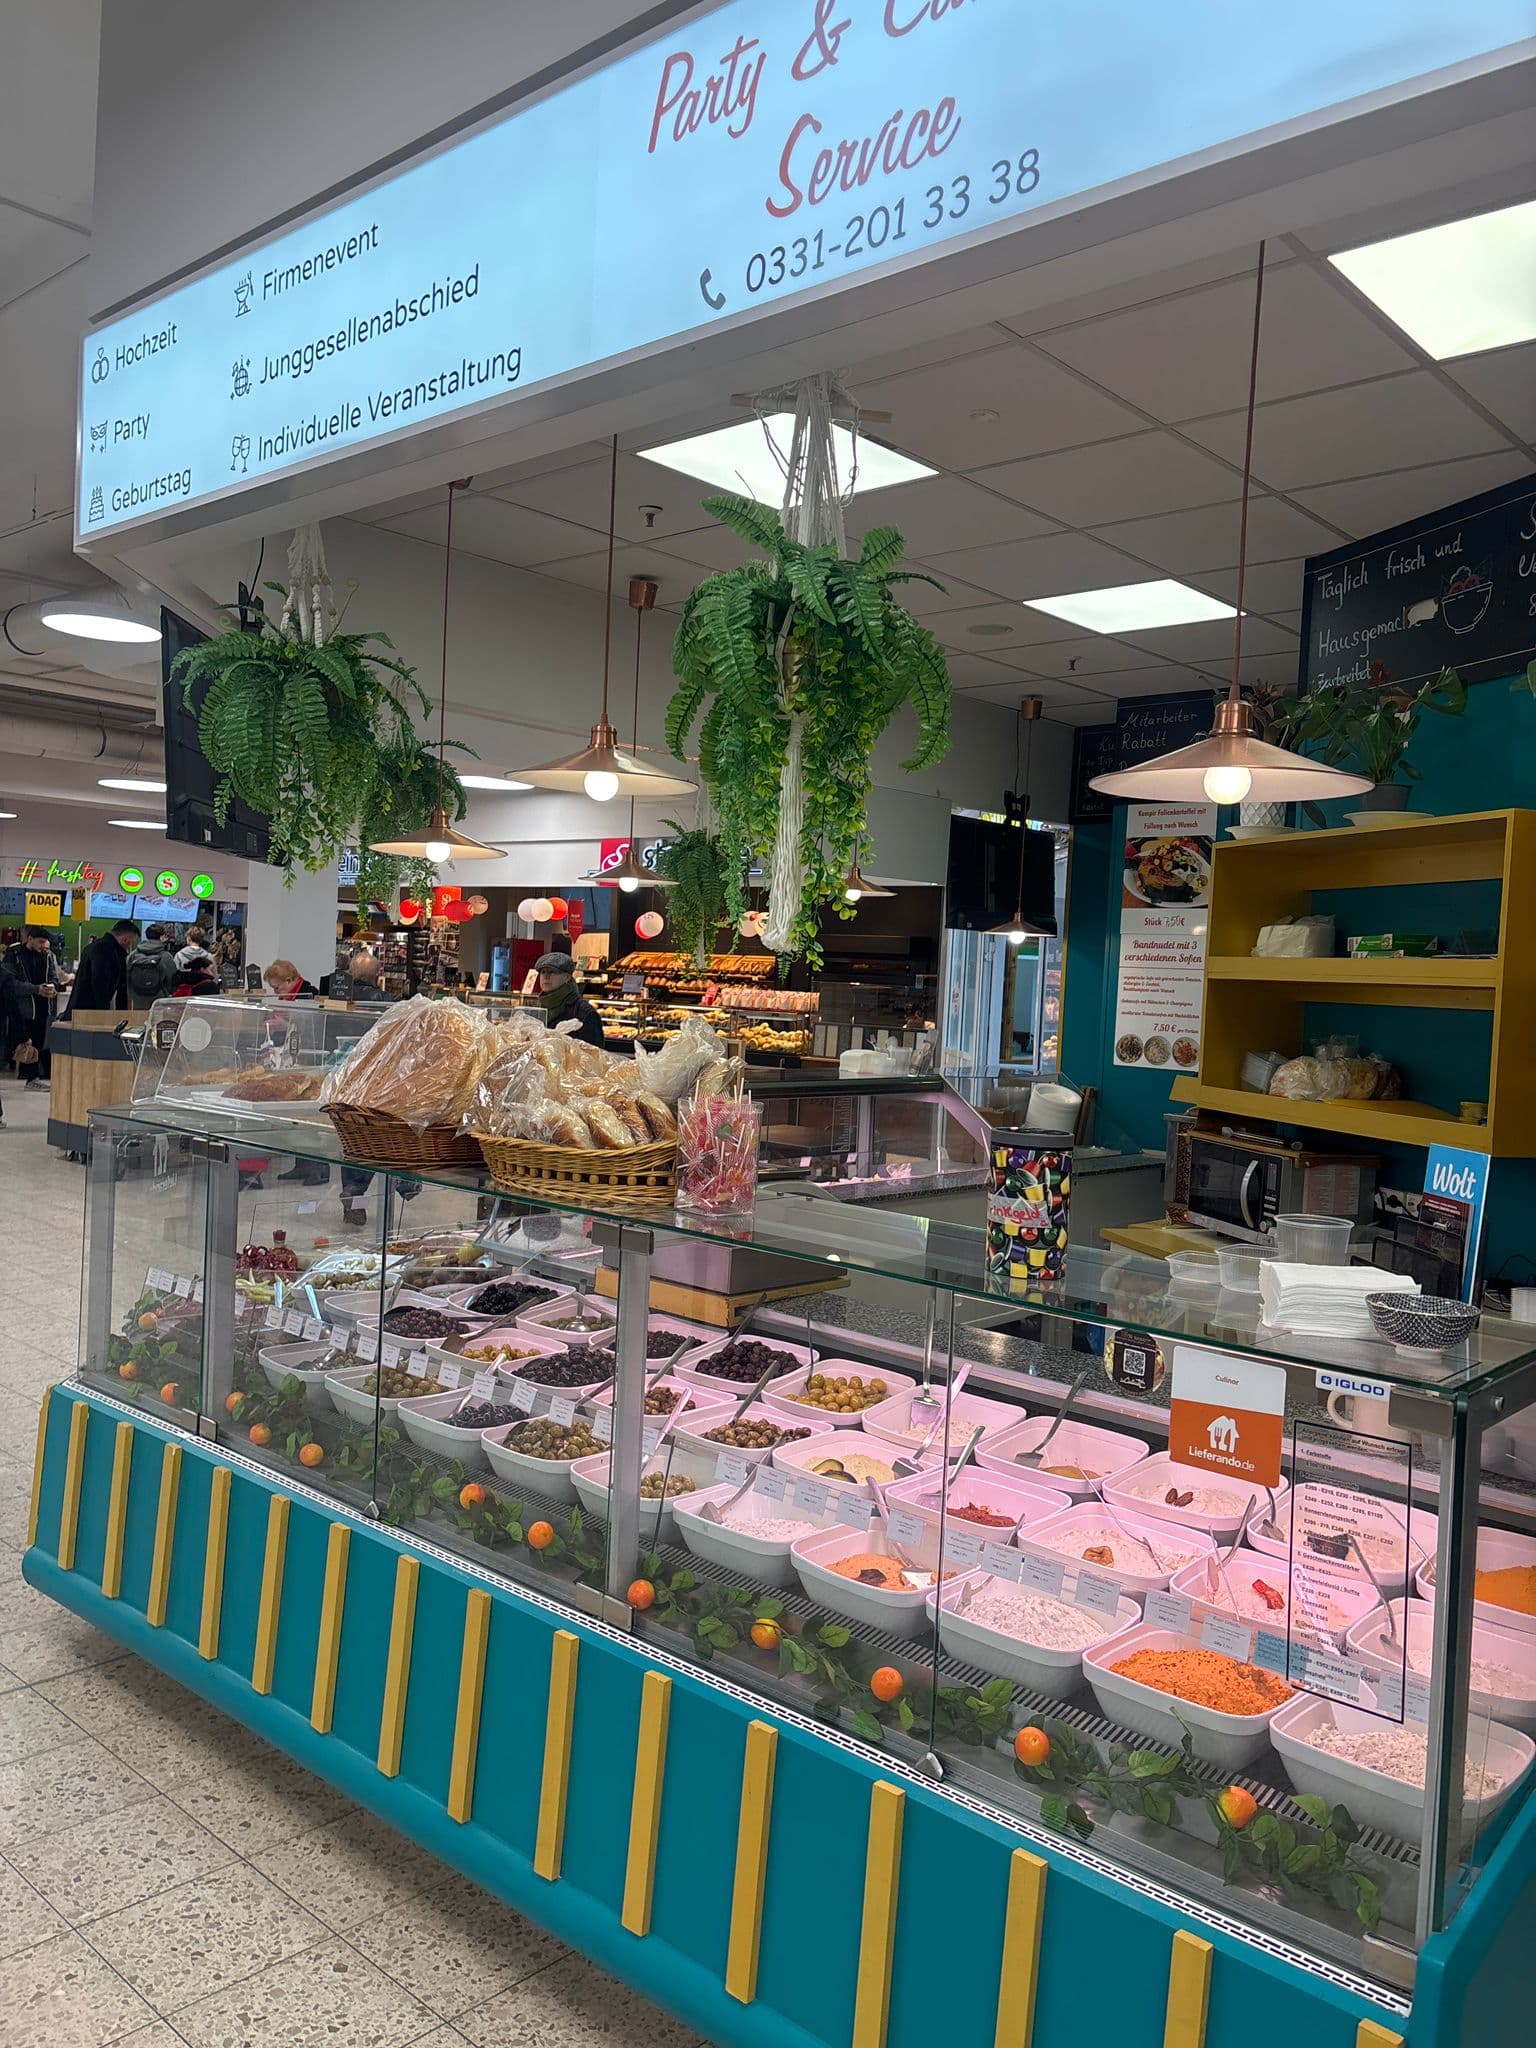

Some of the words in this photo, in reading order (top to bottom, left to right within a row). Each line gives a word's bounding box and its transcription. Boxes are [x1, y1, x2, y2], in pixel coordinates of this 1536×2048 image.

[648, 35, 766, 153] Party
[791, 0, 852, 81] &
[765, 96, 962, 219] Service
[745, 197, 906, 293] 0331-201
[922, 174, 971, 230] 33
[988, 147, 1041, 204] 38
[262, 223, 380, 301] Firmenevent
[259, 263, 480, 386] Junggesellenabschied
[115, 321, 178, 372] Hochzeit
[257, 403, 362, 463] Individuelle
[367, 346, 522, 423] Veranstaltung
[113, 413, 151, 444] Party
[111, 468, 192, 513] Geburtstag
[1317, 561, 1369, 611] Täglich
[1384, 545, 1426, 580] frisch
[1434, 532, 1463, 559] und
[1120, 707, 1199, 730] Mitarbeiter
[1121, 731, 1167, 751] Rabatt
[47, 859, 105, 892] freshtag
[29, 894, 60, 908] ADAC
[1144, 917, 1162, 926] Stück
[1124, 953, 1177, 962] verschiedenen
[1176, 941, 1190, 950] mit
[1191, 941, 1197, 950] 3
[1153, 1023, 1170, 1033] 7,50
[1171, 1023, 1177, 1033] €
[1432, 1163, 1477, 1199] Wolt
[1335, 1378, 1385, 1397] IGLOO
[1188, 1445, 1255, 1472] Lieferando.de
